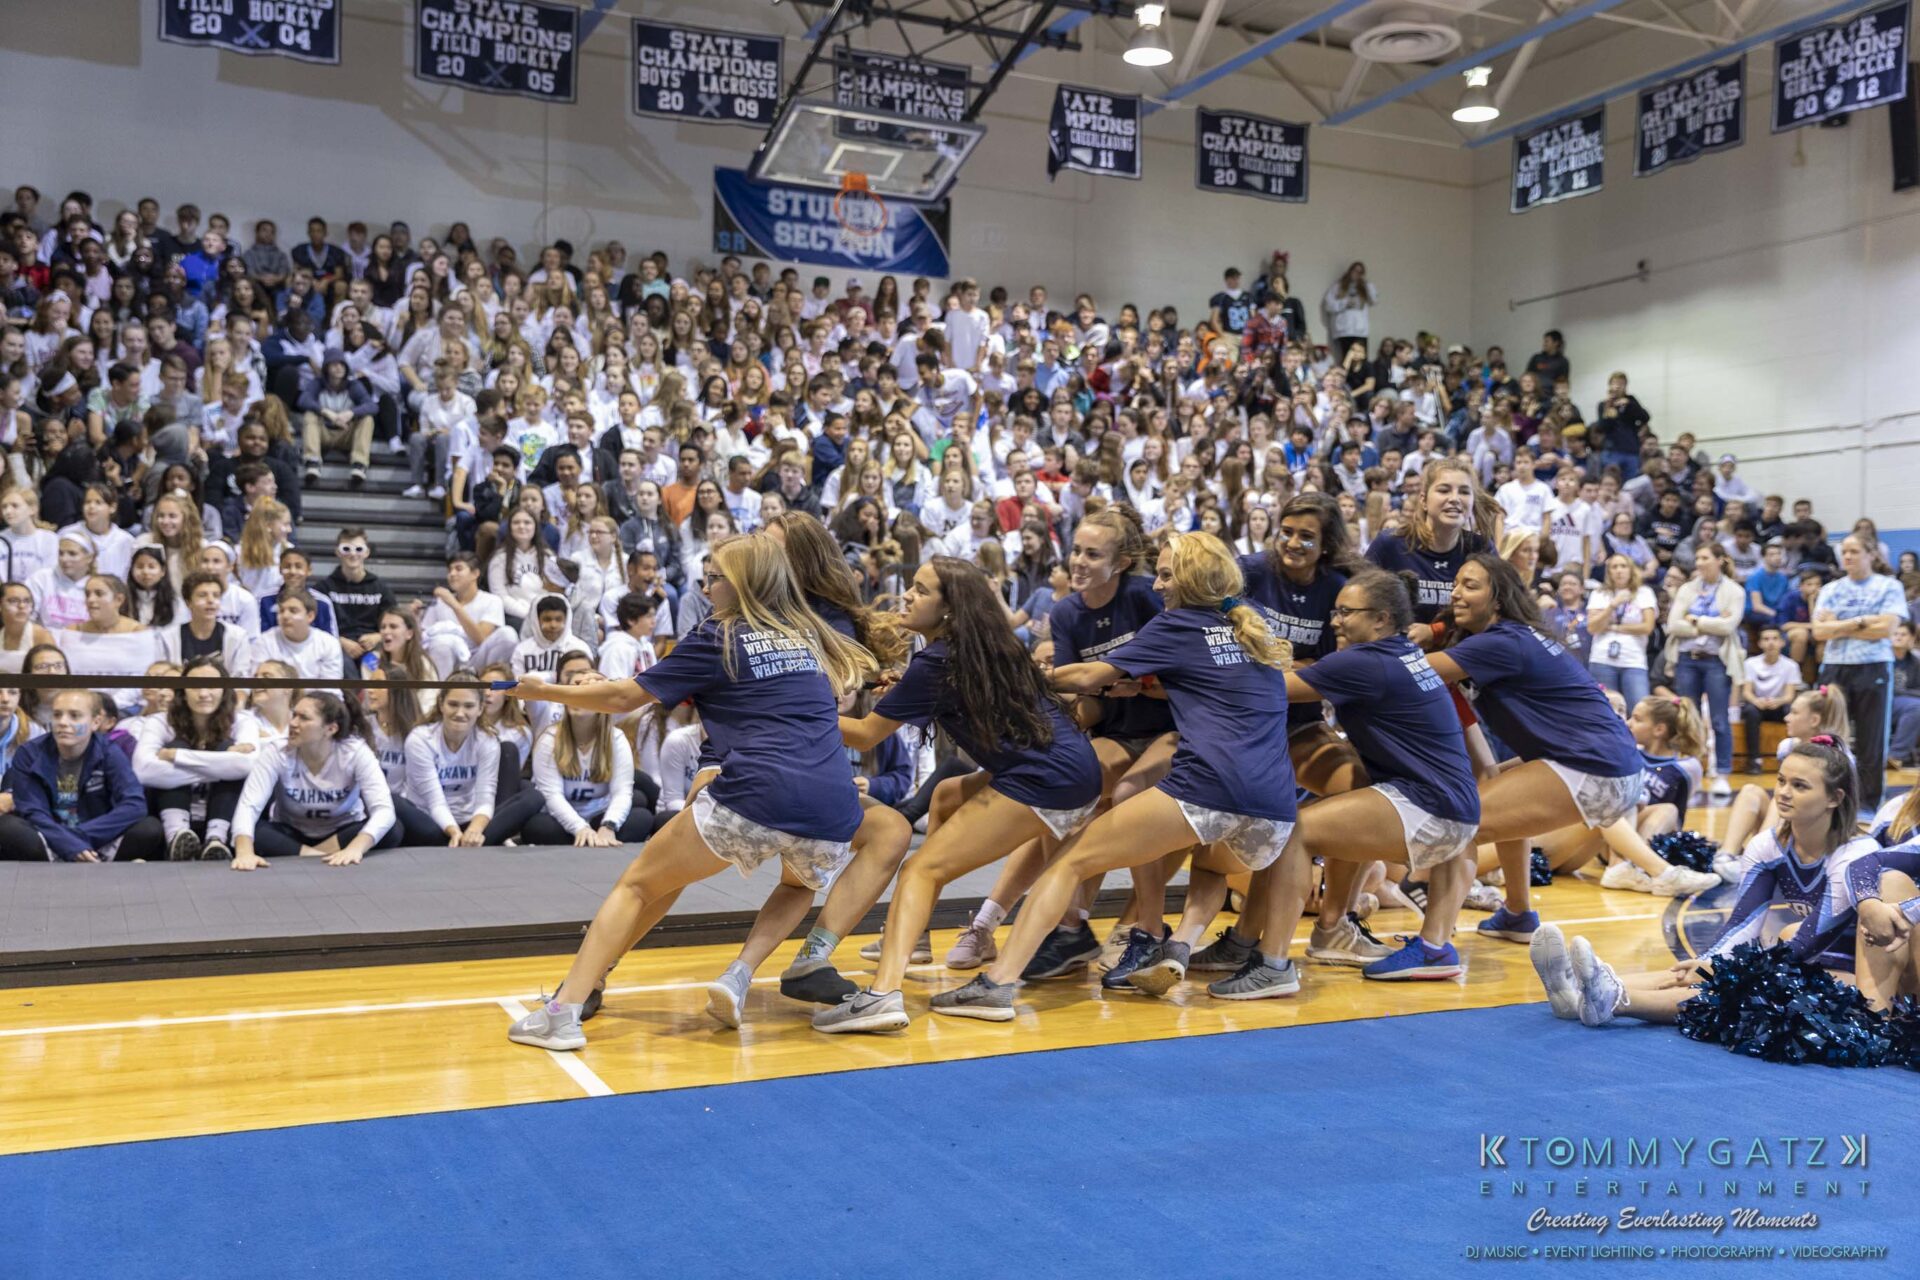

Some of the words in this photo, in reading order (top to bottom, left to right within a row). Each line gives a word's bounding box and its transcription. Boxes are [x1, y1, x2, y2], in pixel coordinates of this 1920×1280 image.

[249, 0, 323, 30] HOCKEY
[454, 0, 539, 27] STATE
[190, 13, 222, 34] 20
[279, 24, 311, 50] 04
[422, 7, 572, 52] CHAMPIONS
[669, 30, 748, 58] STATE
[1800, 15, 1877, 57] STATE
[431, 31, 481, 57] FIELD
[494, 42, 562, 71] HOCKEY
[640, 45, 777, 80] CHAMPIONS
[436, 55, 465, 77] 20
[527, 70, 555, 93] 05
[640, 65, 685, 88] BOYS'
[698, 72, 777, 99] LACROSSE
[657, 89, 684, 111] 20
[734, 97, 759, 119] 09
[1652, 69, 1720, 110] STATE
[1793, 94, 1819, 119] 20
[1856, 76, 1880, 101] 12
[1220, 117, 1285, 143] STATE
[1703, 124, 1726, 145] 12
[1202, 131, 1302, 162] CHAMPIONS
[1214, 168, 1238, 186] 20
[1271, 177, 1284, 195] 11
[768, 187, 901, 230] STUDENT
[743, 640, 774, 656] WHAT
[1205, 632, 1233, 647] WHAT
[1209, 646, 1221, 655] SO
[749, 656, 761, 666] SO
[751, 661, 784, 680] WHAT
[1212, 652, 1243, 667] WHAT
